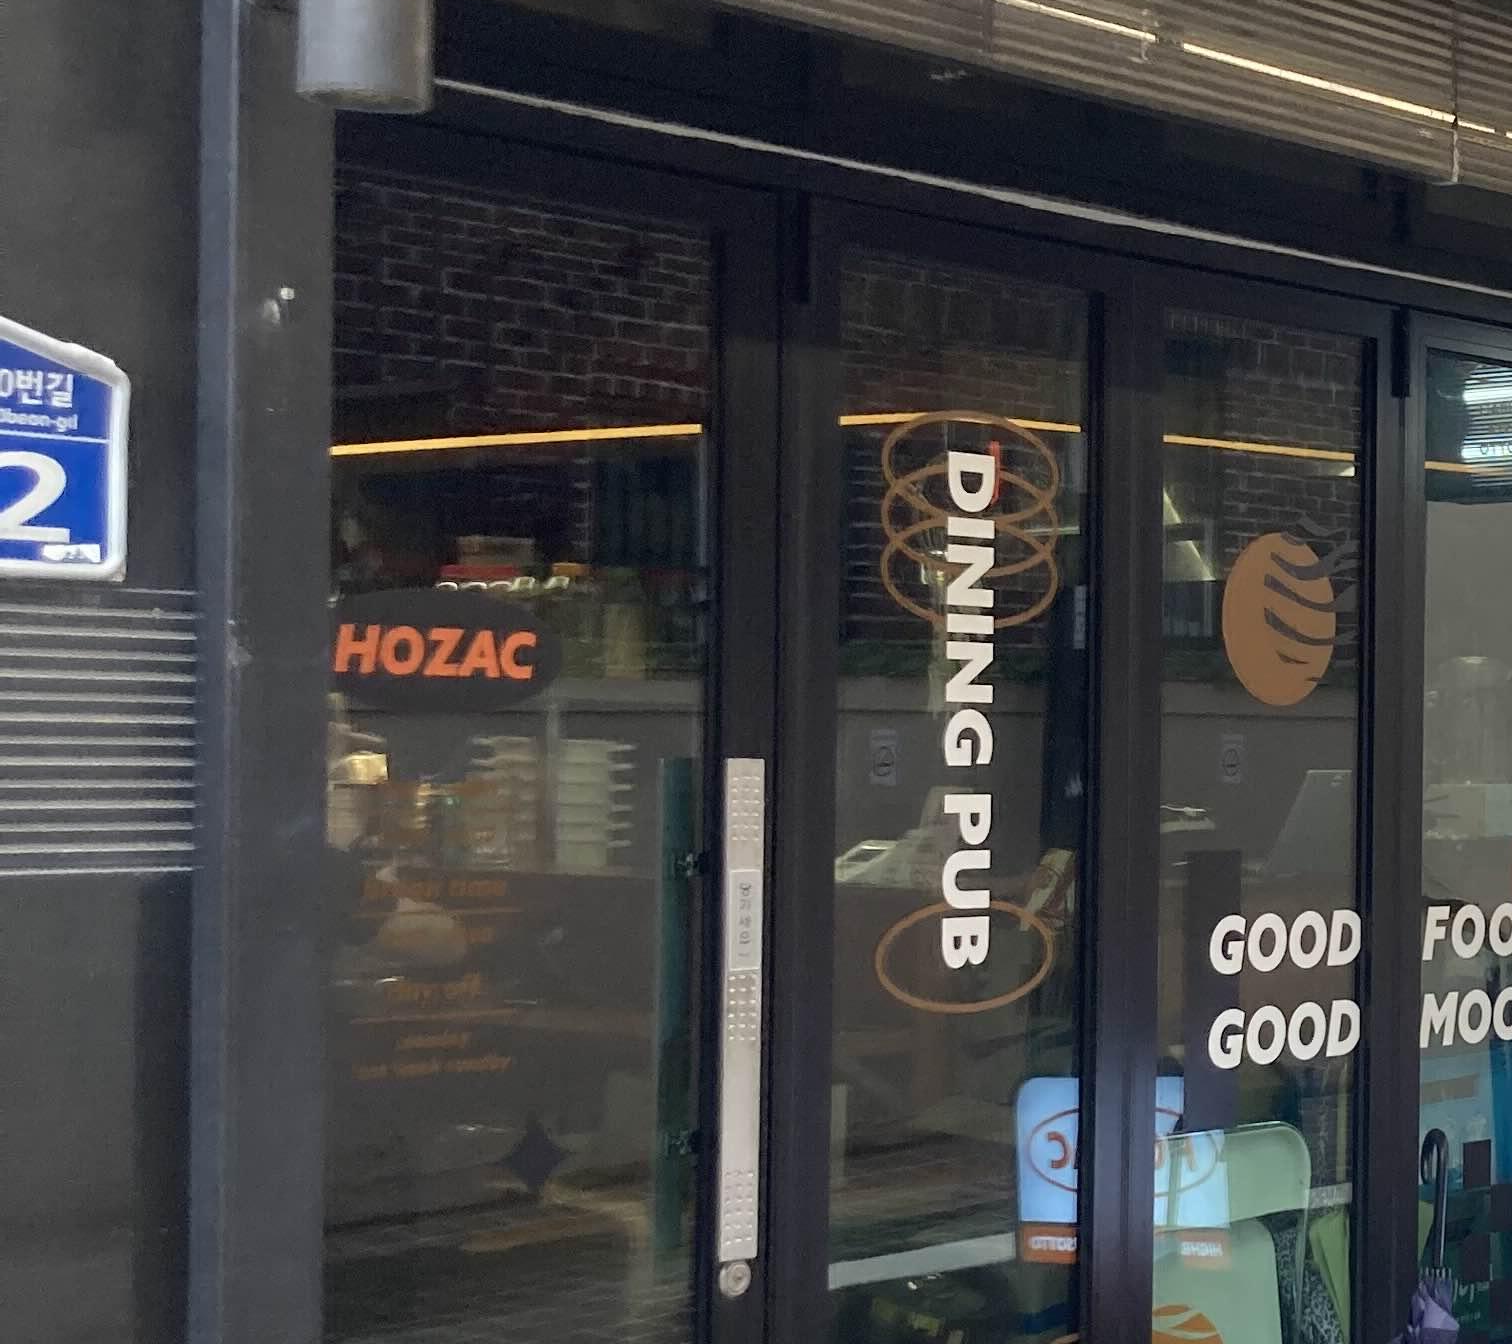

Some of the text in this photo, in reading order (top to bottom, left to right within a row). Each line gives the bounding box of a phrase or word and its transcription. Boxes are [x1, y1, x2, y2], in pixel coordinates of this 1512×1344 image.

[334, 623, 537, 680] HOZAC
[941, 450, 996, 969] DINING PUB
[1209, 909, 1361, 975] GOOD
[1207, 999, 1361, 1069] GOOD
